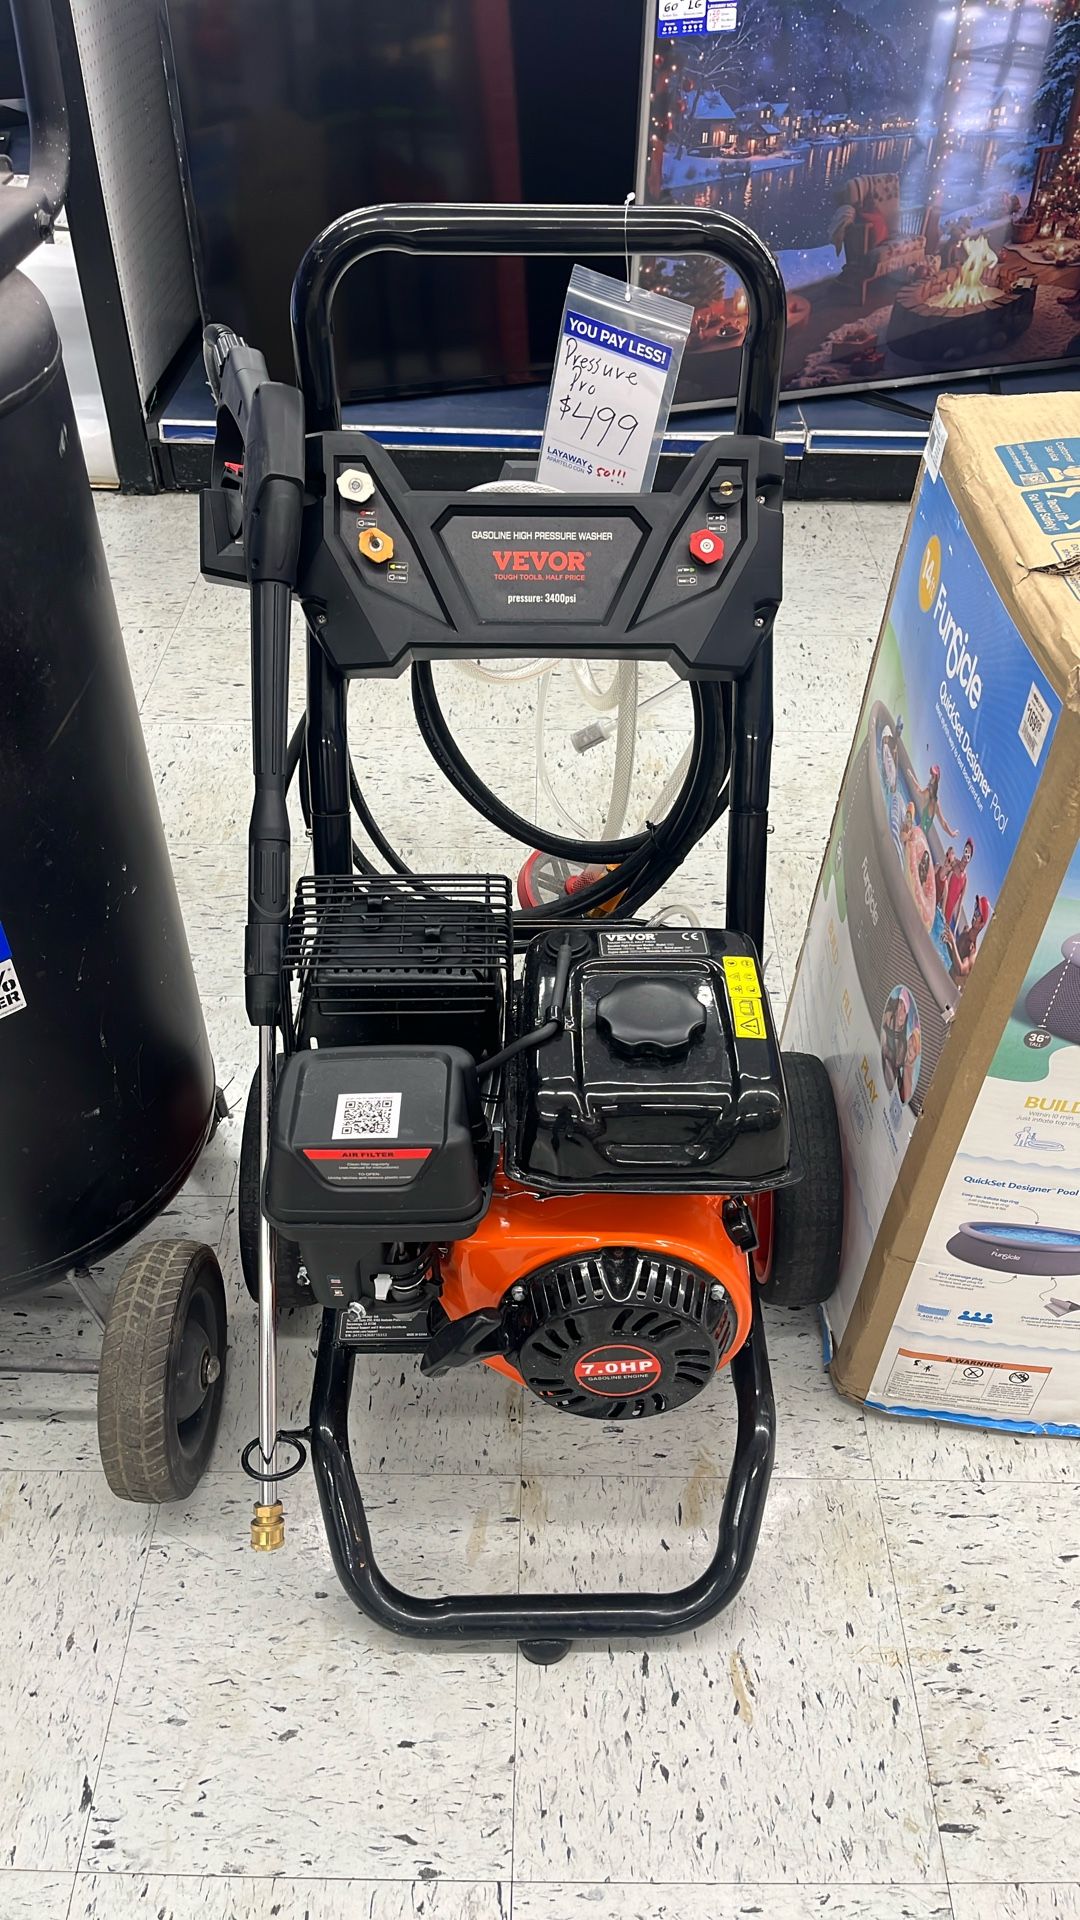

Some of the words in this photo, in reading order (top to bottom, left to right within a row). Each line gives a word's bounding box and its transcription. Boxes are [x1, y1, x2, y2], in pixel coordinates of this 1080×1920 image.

[569, 317, 598, 338] YOU
[600, 330, 627, 348] PAY
[628, 340, 667, 364] LESS!
[565, 338, 638, 386] Pressure
[570, 365, 596, 395] Pro
[560, 395, 638, 455] $499
[546, 455, 573, 470] APARTELO
[547, 446, 588, 467] LAYAWAY
[471, 531, 511, 540] GASOLINE
[513, 531, 532, 540] HIGH
[534, 531, 576, 541] PRESSURE
[578, 532, 613, 541] WASHER
[492, 551, 586, 571] VEVOR
[494, 573, 518, 581] TOUGH
[508, 594, 543, 605] pressure:
[545, 593, 577, 604] 3400psi
[934, 582, 982, 709] Funsicle
[940, 681, 965, 743] QuickSet
[961, 731, 992, 798] Designer
[990, 793, 1009, 835] Pool
[1029, 1033, 1049, 1043] 36"
[964, 1175, 1006, 1188] QuickSet
[1008, 1182, 1051, 1193] Designer
[1057, 1188, 1079, 1196] Pool
[581, 1361, 653, 1375] 7.0HP
